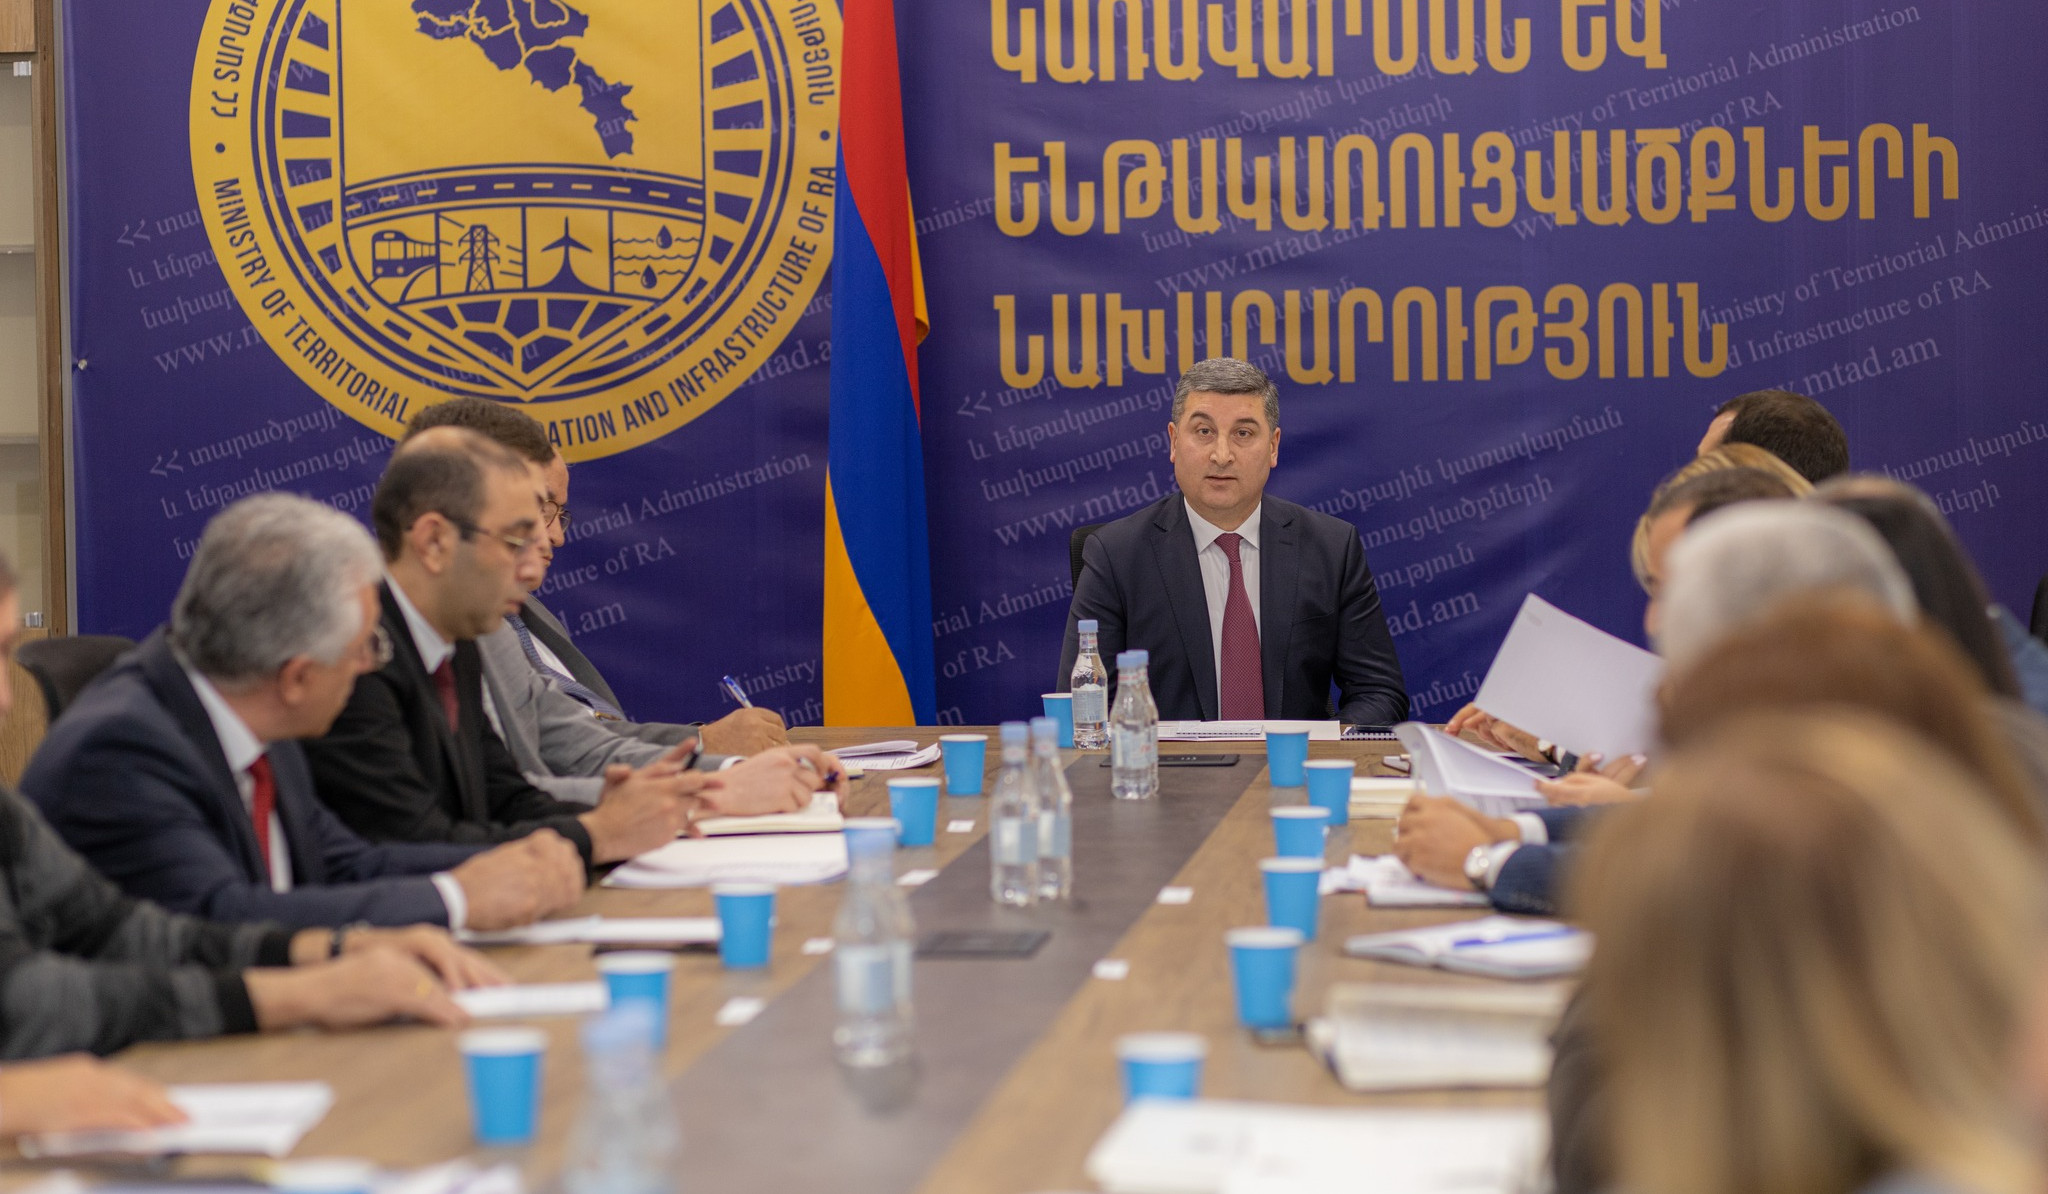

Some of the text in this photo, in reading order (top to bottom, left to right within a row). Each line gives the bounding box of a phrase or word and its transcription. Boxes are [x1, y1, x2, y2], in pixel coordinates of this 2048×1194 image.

[213, 0, 258, 82] ՏԱՐԱԾ
[790, 0, 835, 105] ՈՒԹՅՈՒՆ
[1591, 93, 1618, 122] of
[1619, 56, 1740, 112] Territorial
[1746, 4, 1923, 75] Administration
[1709, 90, 1784, 126] of RA
[807, 166, 836, 197] RA
[993, 123, 1959, 237] ԵՆԹԱԿԱՌՈՒՑՎԱԾՔՆԵՐԻ
[213, 178, 276, 289] MINISTRY
[797, 201, 829, 234] OF
[261, 288, 295, 318] OF
[1794, 273, 1823, 304] of
[1823, 234, 1949, 293] Territorial
[668, 235, 818, 407] INFRASTRUCTURE
[1747, 296, 1912, 364] Infrastructure
[1917, 280, 1945, 311] of
[1947, 269, 1994, 301] RA
[284, 315, 410, 425] TERRITORIAL
[621, 389, 670, 432] AND
[639, 451, 813, 522] Administration
[604, 548, 631, 576] of
[632, 535, 677, 567] RA
[943, 639, 1017, 679] of RA
